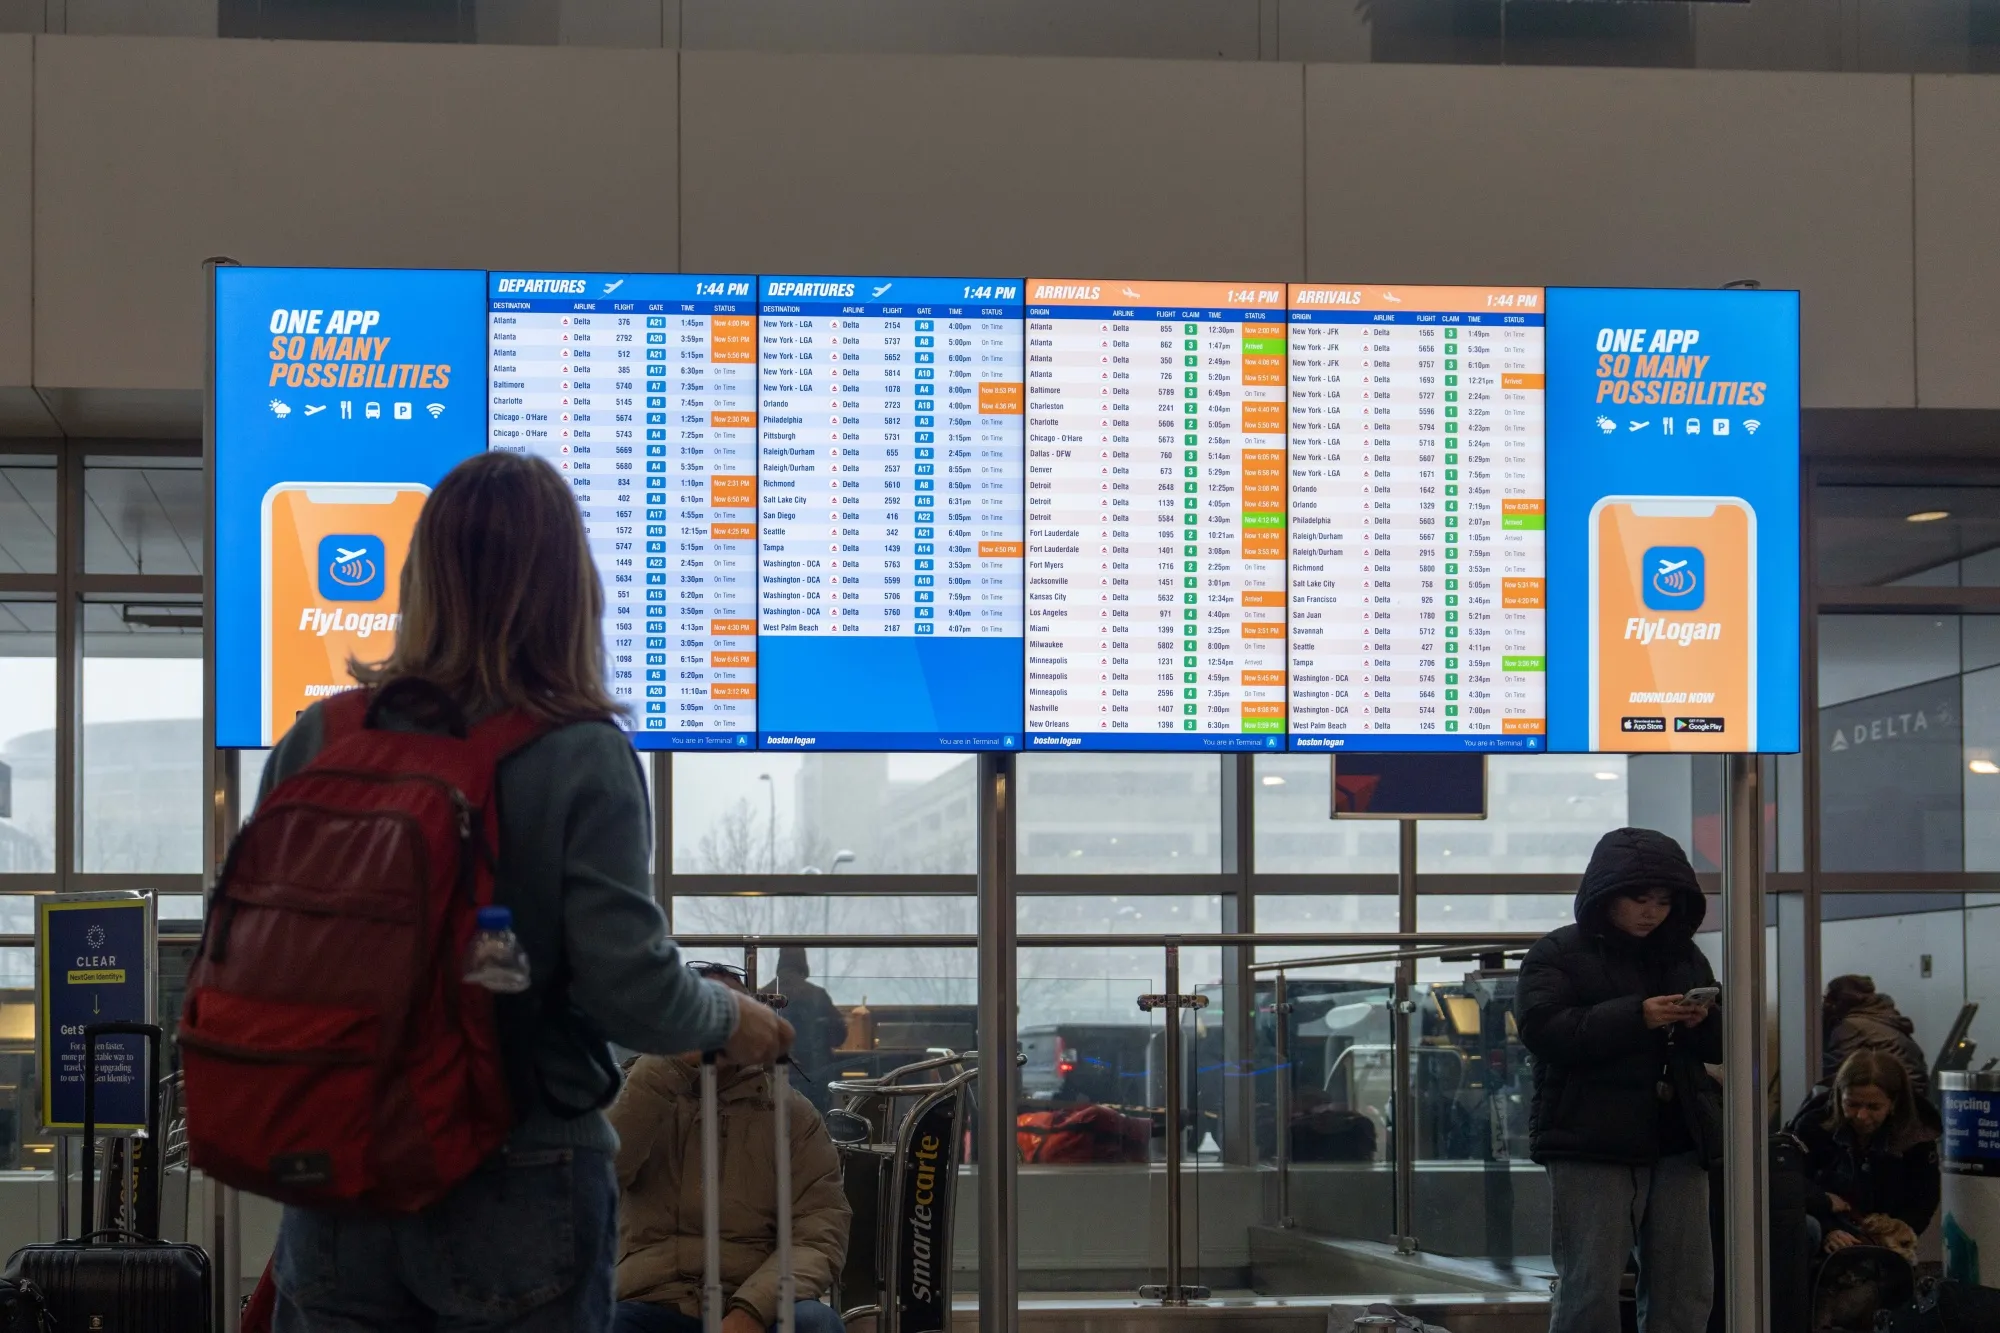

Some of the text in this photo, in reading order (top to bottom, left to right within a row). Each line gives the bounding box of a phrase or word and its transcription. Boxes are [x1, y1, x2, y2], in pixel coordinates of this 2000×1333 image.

[499, 279, 749, 296] DEPARTURES 1:44 PM
[768, 283, 1016, 299] DEPARTURES 1:44 PM
[1034, 286, 1279, 303] ARRIVALS 1:44 PM
[1297, 290, 1537, 307] ARRIVALS 1:44 PM
[614, 303, 634, 311] FLIGHT
[269, 309, 380, 335] ONE APP
[1596, 328, 1699, 353] ONE APP
[269, 336, 391, 361] SO MANY
[1596, 354, 1710, 378] SO MANY
[269, 363, 451, 389] POSSIBILITIES
[493, 381, 524, 389] Baltimore
[616, 382, 632, 390] 5740
[652, 382, 661, 391] A7
[681, 383, 703, 392] 7:35pm
[1596, 380, 1766, 405] POSSIBILITIES
[1030, 402, 1064, 410] Charleston
[1113, 403, 1129, 411] Delta
[1158, 404, 1174, 412] 2241
[1209, 405, 1230, 414] 4:04pm
[763, 416, 803, 424] Philadelphia
[843, 416, 859, 424] Delta
[920, 417, 928, 425] A3
[949, 418, 971, 427] 7:50pm
[763, 496, 776, 504] Salt
[778, 496, 792, 504] Lake
[794, 496, 807, 505] City
[843, 496, 859, 504] Delta
[918, 497, 931, 505] A16
[949, 498, 971, 506] 6:31pm
[1293, 627, 1323, 635] Savannah
[1375, 627, 1390, 635] Delta
[1469, 628, 1490, 636] 5:33pm
[1624, 618, 1721, 646] FlyLogan
[1112, 641, 1129, 649] Delta
[1188, 642, 1193, 650] 4
[1208, 643, 1230, 651] 8:00pm
[1629, 692, 1715, 703] DOWNLOAD NOW
[1689, 723, 1709, 731] Google
[1854, 711, 1927, 744] DELTA
[767, 736, 793, 745] boston
[794, 737, 815, 746] logan
[1034, 736, 1059, 746] boston
[1060, 737, 1081, 747] logan
[1297, 737, 1323, 746] boston
[1323, 738, 1344, 748] logan
[1497, 739, 1522, 747] Terminal
[77, 956, 116, 967] CLEAR
[70, 973, 95, 981] NextGen
[61, 1025, 76, 1035] Get
[70, 1042, 80, 1050] For
[100, 1063, 131, 1073] upgrading
[909, 1134, 939, 1303] smartecarte
